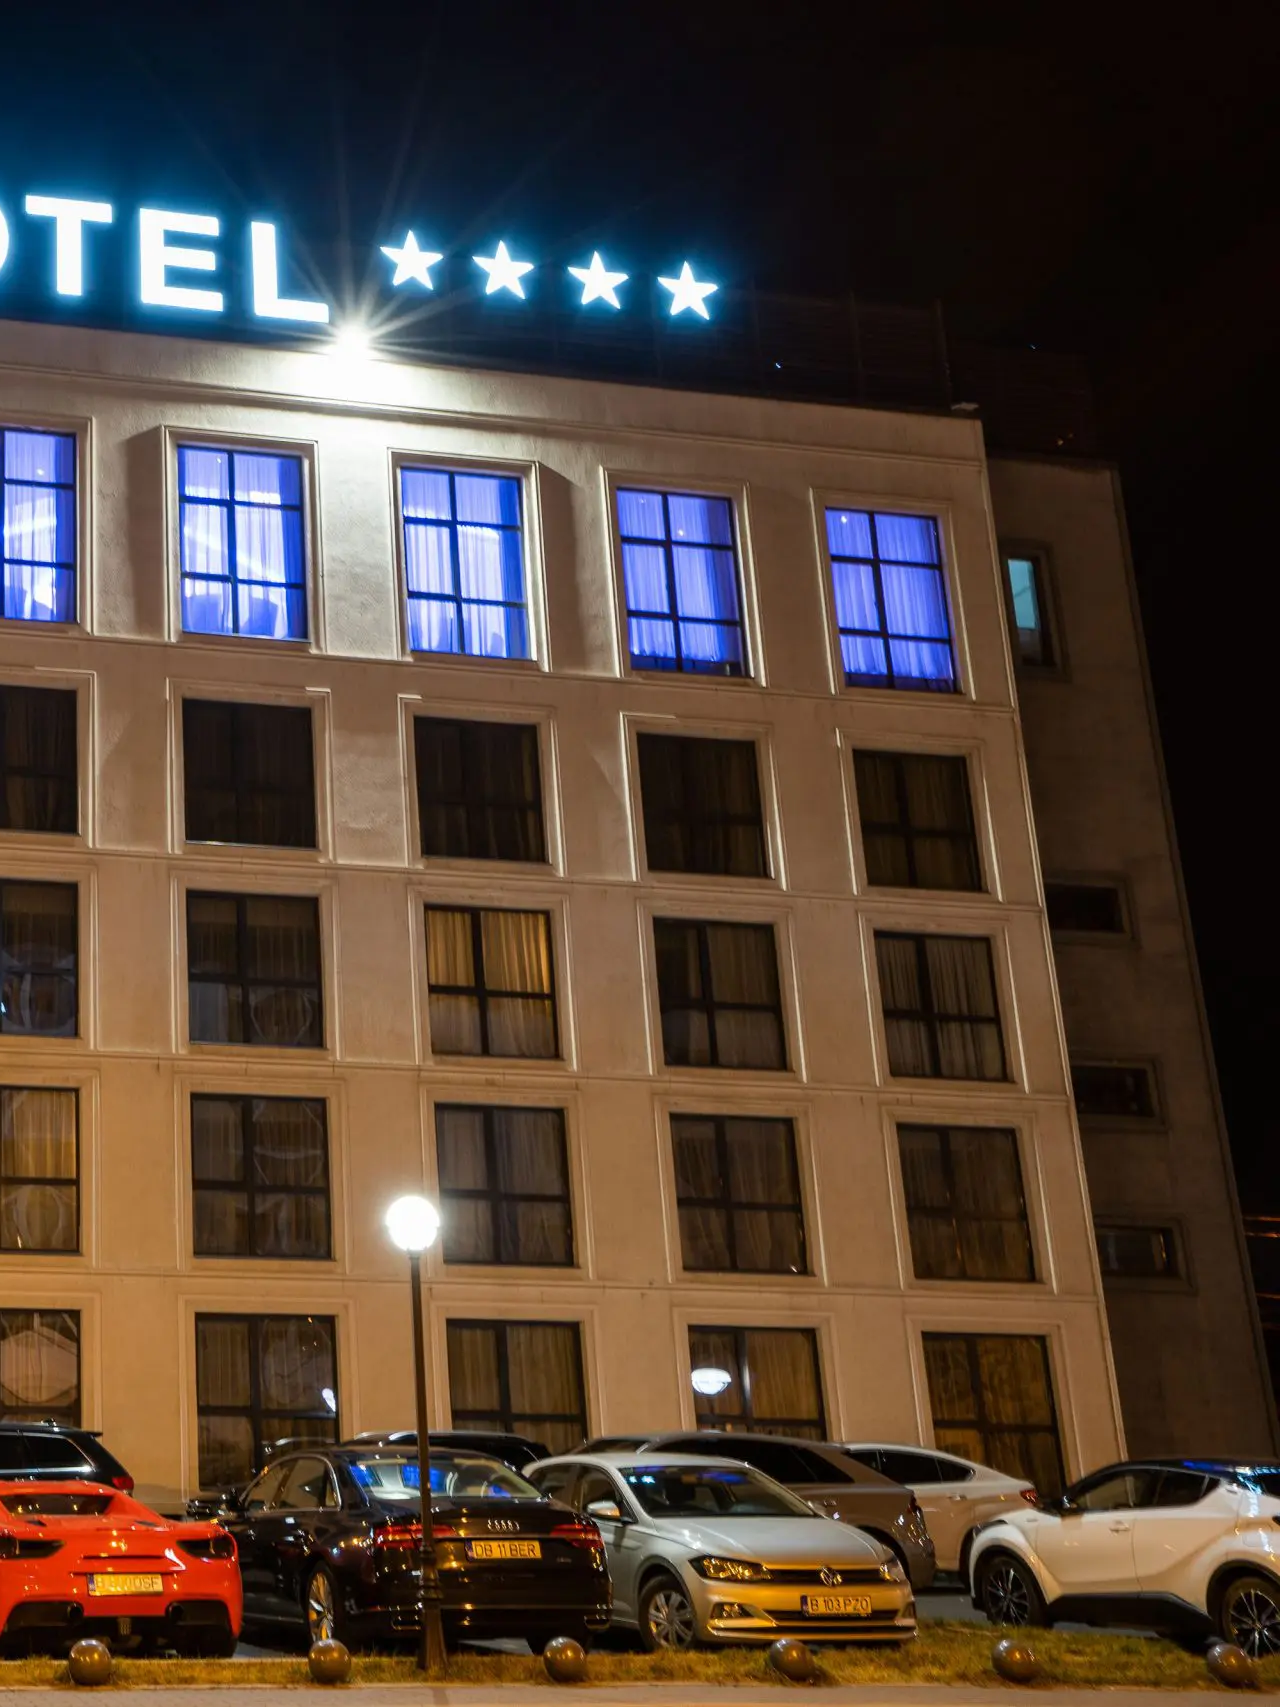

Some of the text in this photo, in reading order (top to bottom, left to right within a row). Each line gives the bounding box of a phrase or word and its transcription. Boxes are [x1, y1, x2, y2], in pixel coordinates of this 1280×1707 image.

[475, 1543, 493, 1557] DB
[509, 1543, 537, 1557] BER
[811, 1598, 819, 1611] B
[823, 1598, 841, 1612] 103
